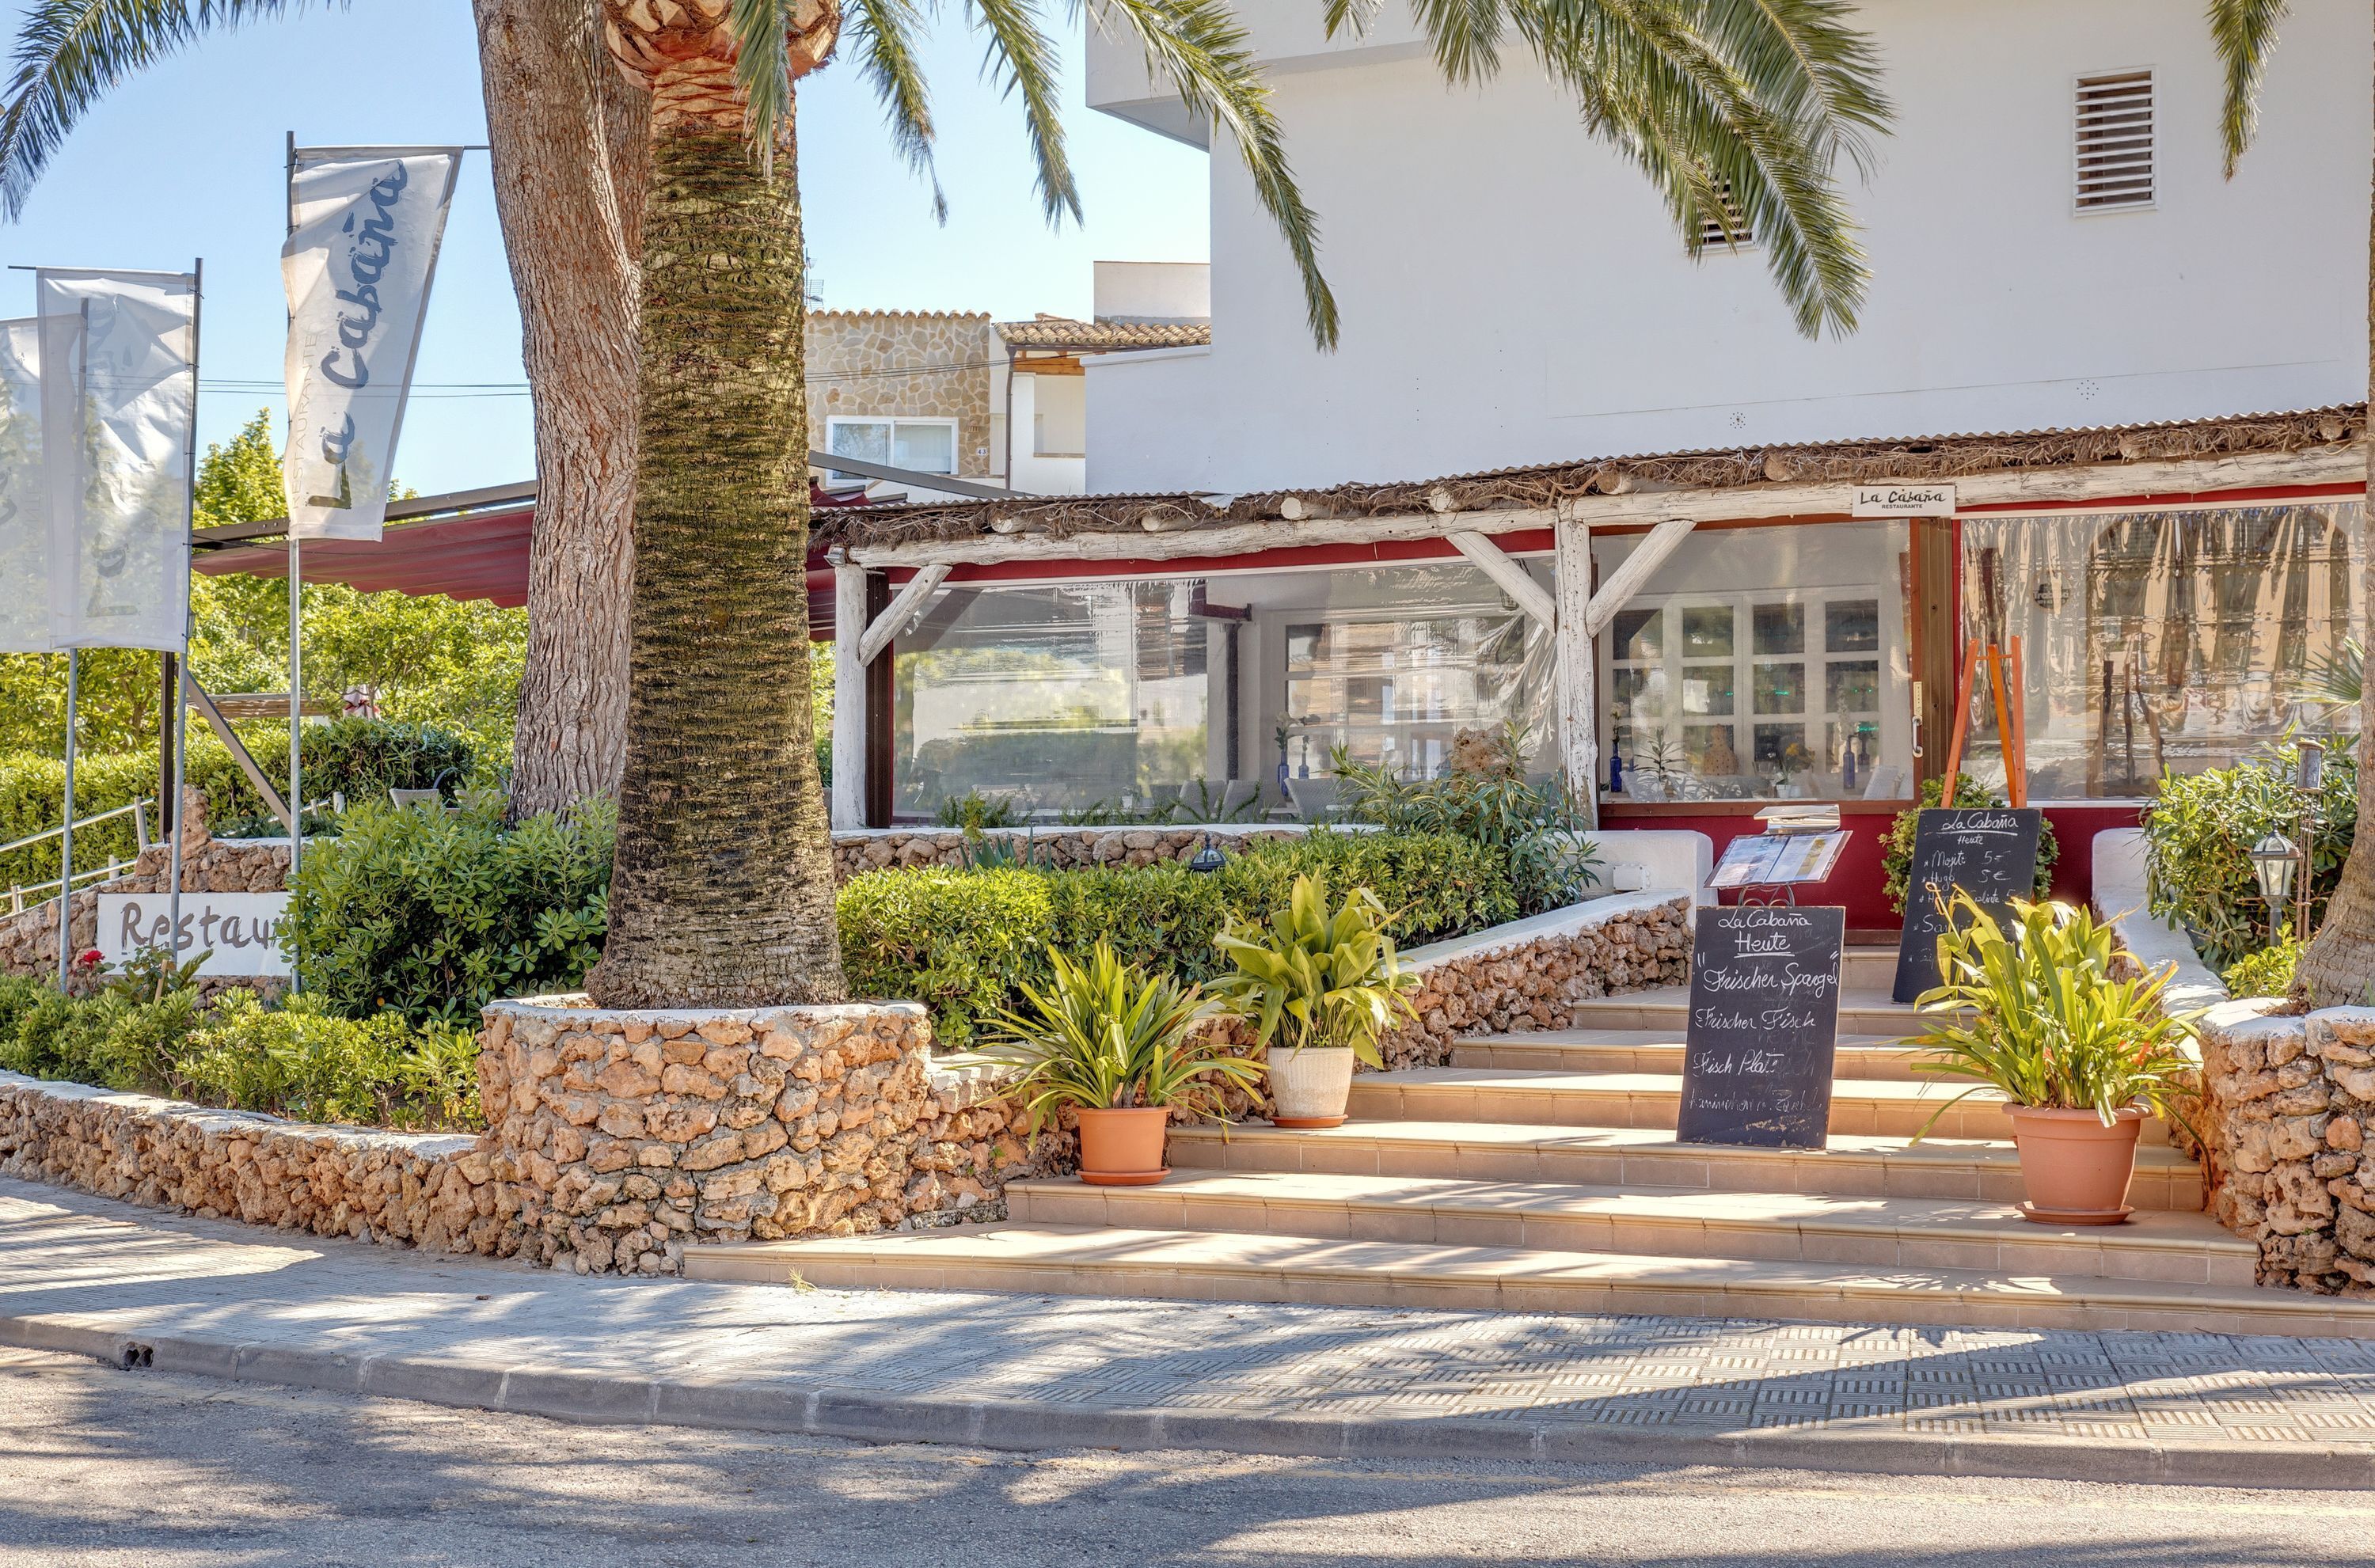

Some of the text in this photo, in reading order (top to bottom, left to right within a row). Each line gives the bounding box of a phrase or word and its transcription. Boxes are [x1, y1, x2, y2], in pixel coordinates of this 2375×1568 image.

[305, 158, 408, 510] La Cabaña
[1860, 488, 1947, 504] La Cabaña
[1941, 811, 2019, 831] La Cabaña
[1957, 835, 1984, 845] Heute
[1930, 870, 1955, 892] Hugo
[1717, 909, 1813, 929] La Cabaña
[1734, 930, 1791, 952] Heute
[1695, 1005, 1817, 1030] Frischer Fisch
[1693, 1049, 1733, 1078] Fisch
